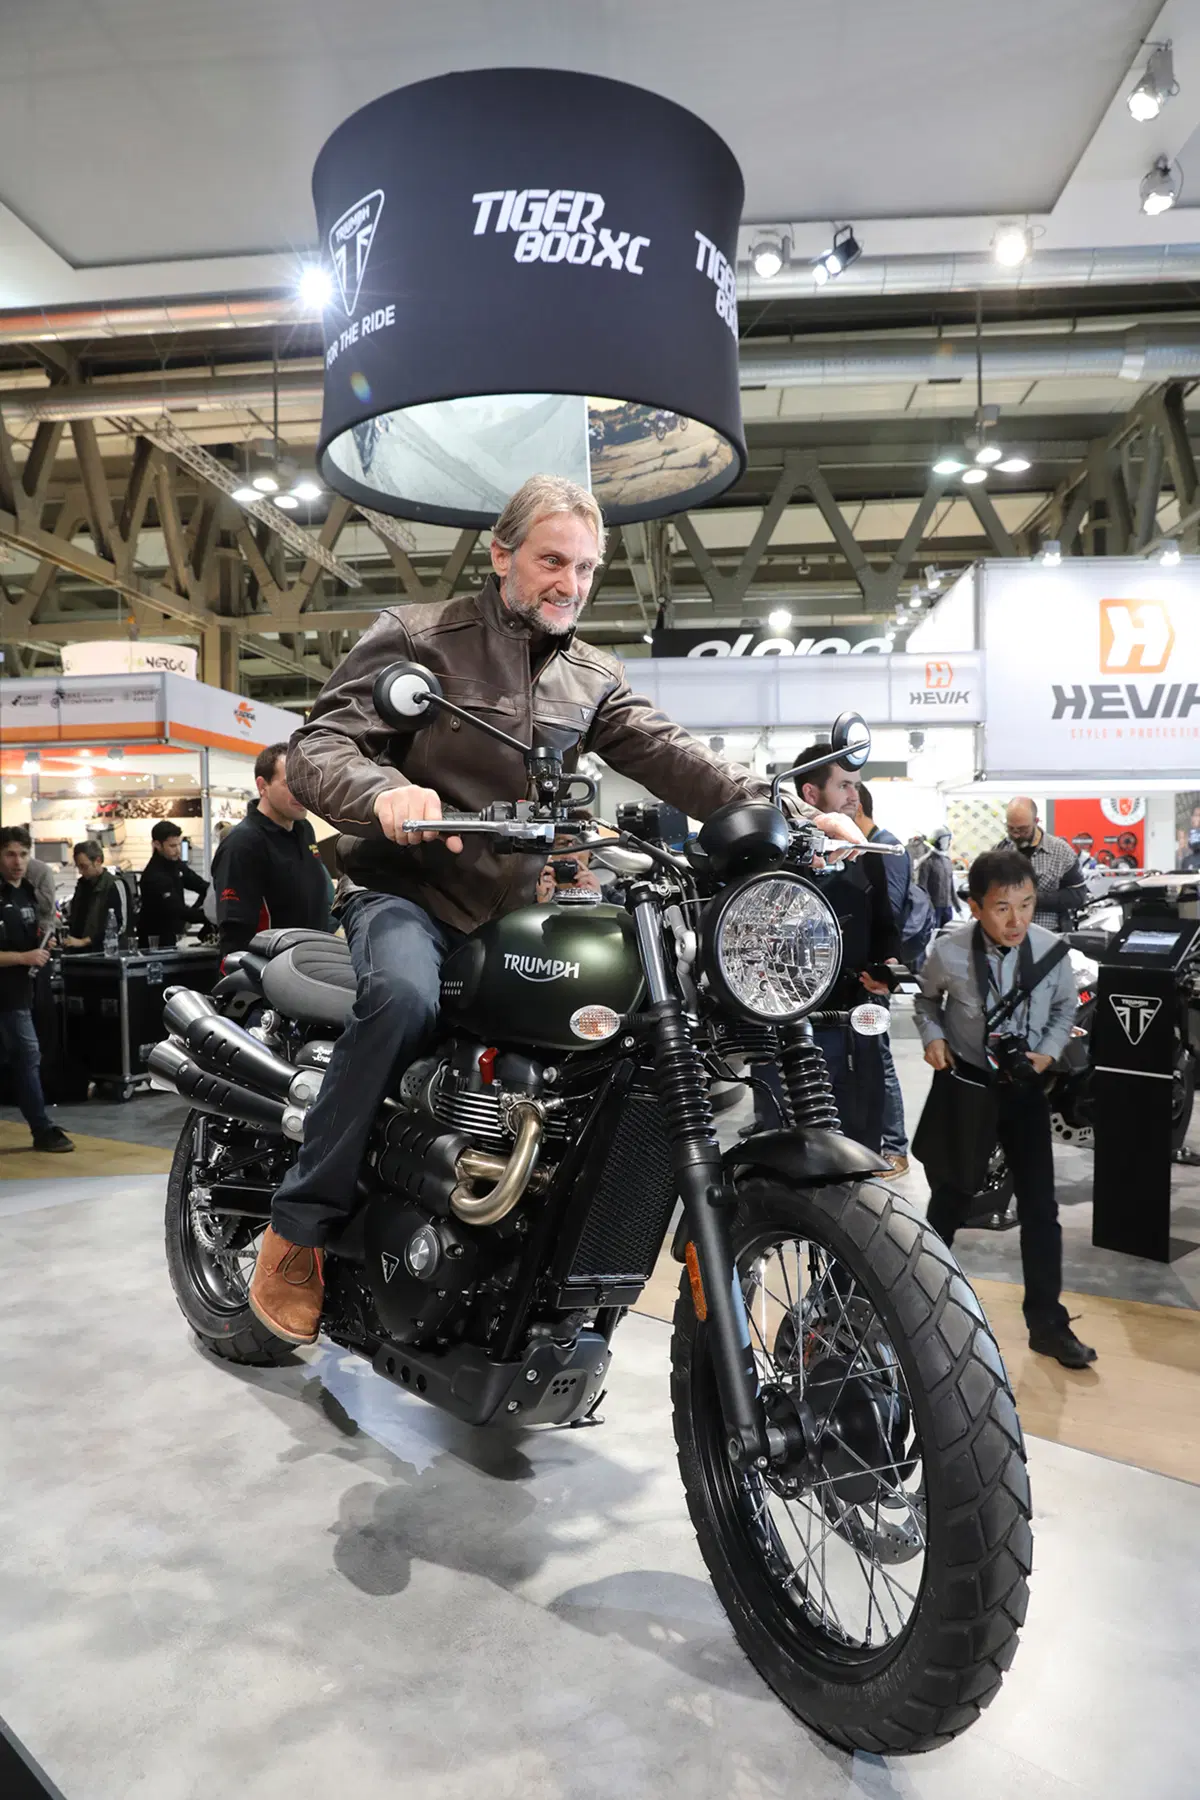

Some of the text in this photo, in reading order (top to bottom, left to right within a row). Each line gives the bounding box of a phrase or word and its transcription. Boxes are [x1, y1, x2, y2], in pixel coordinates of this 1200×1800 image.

[335, 204, 370, 243] TRIUMPH
[472, 189, 605, 235] TIGER
[694, 230, 736, 303] TIGE
[326, 304, 396, 370] FOR THE RIDE
[909, 691, 970, 705] HEVIK
[504, 953, 580, 982] TRIUMPH
